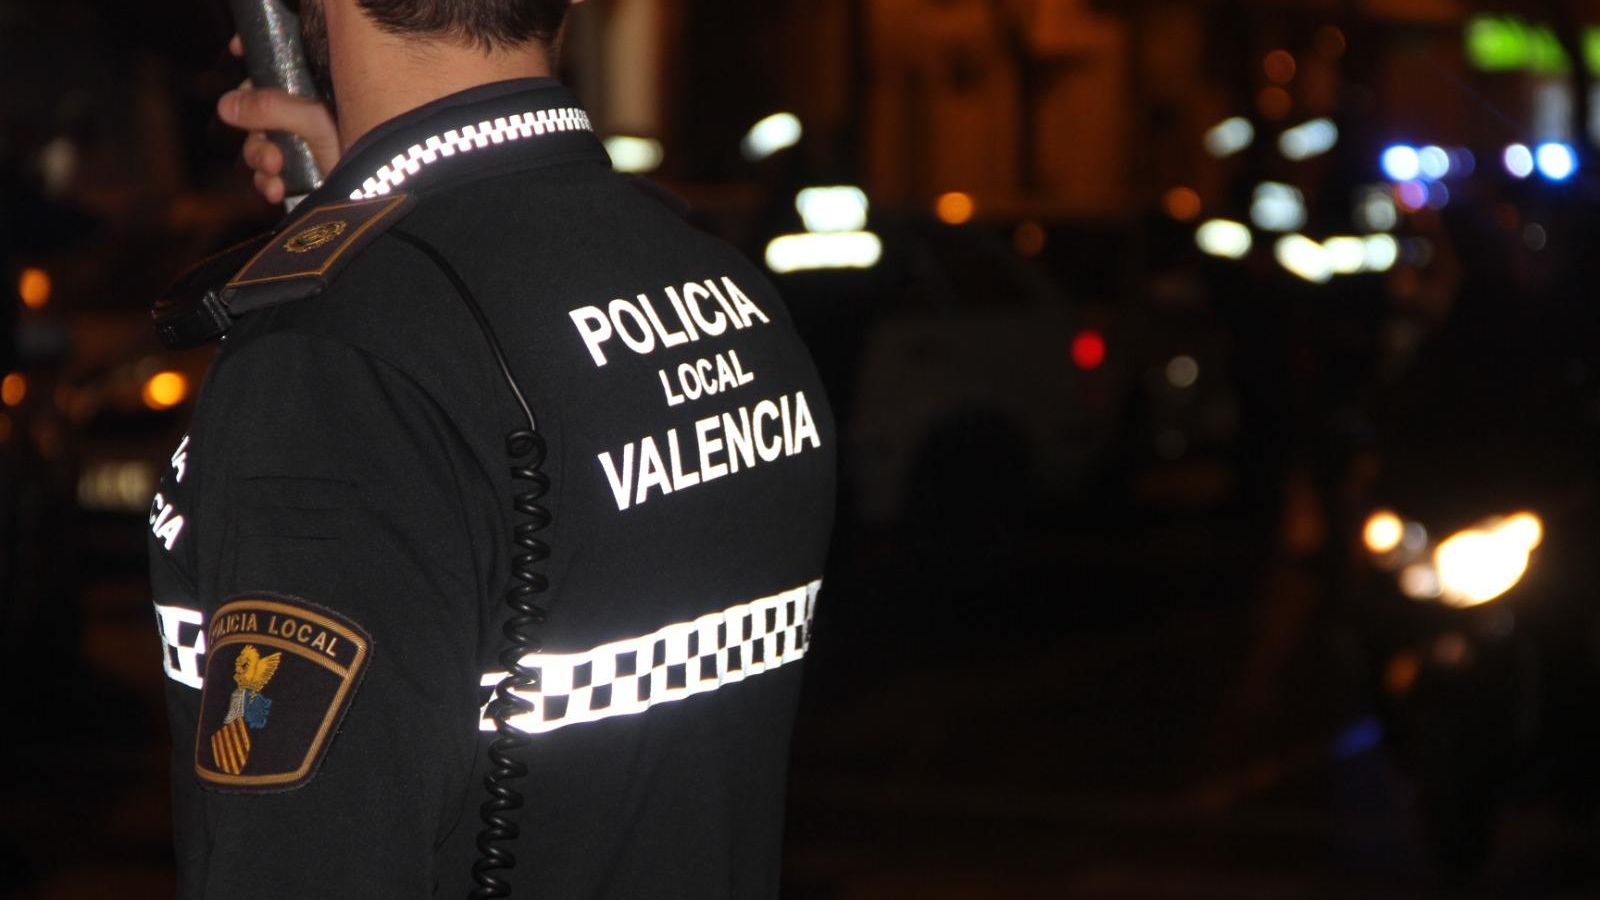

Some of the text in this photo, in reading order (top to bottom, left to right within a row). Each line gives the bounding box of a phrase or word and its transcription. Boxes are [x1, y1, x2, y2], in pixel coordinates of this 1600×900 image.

[569, 276, 770, 367] POLICIA
[658, 349, 754, 406] LOCAL
[597, 391, 821, 511] VALENCIA
[267, 614, 338, 657] LOCAL
